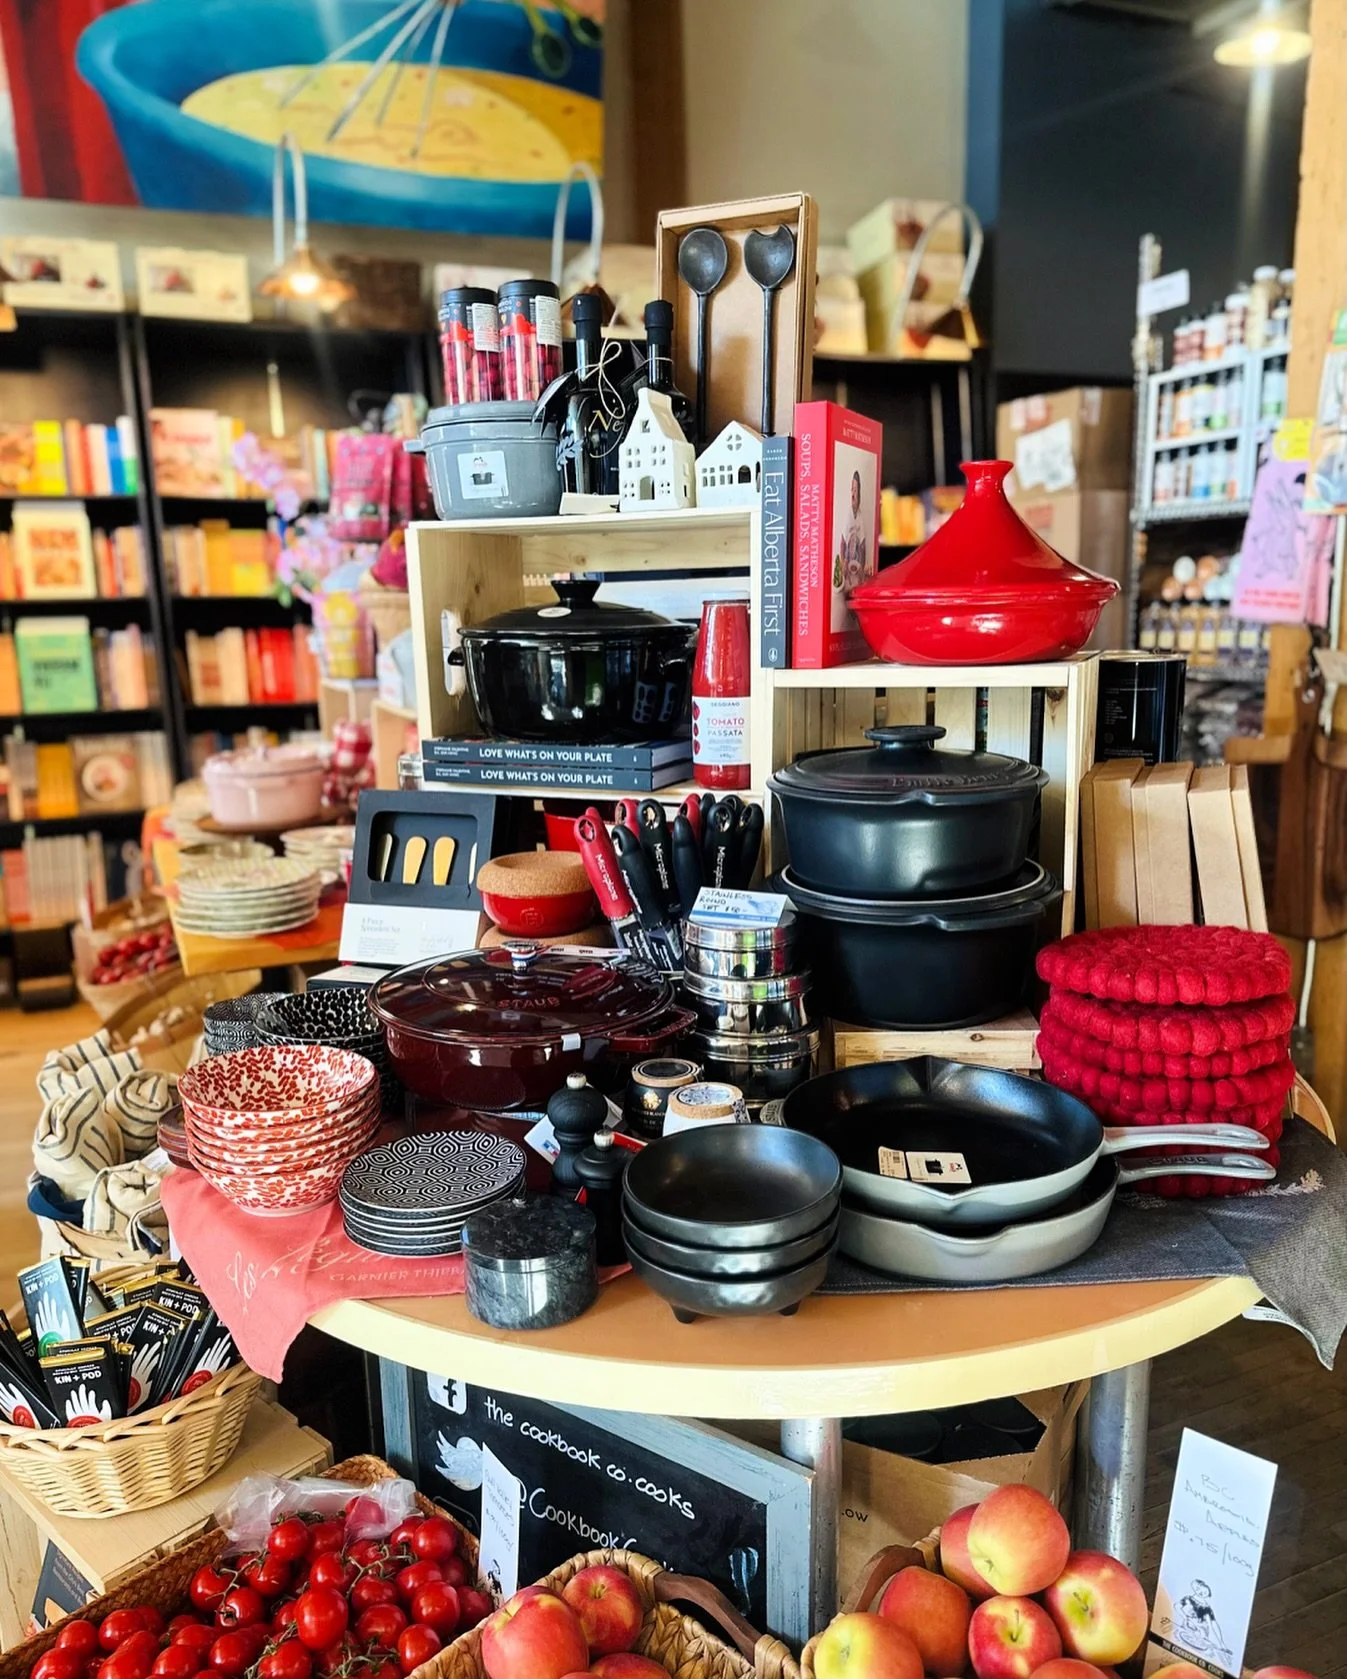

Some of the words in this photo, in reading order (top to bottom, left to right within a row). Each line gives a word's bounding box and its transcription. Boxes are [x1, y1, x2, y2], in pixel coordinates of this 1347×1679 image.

[800, 433, 811, 481] SOUPS,
[764, 472, 784, 507] Eat
[811, 484, 820, 523] MATTY
[799, 484, 810, 542] SALADS,
[764, 510, 785, 588] Alberta
[810, 525, 819, 588] MATHESON
[798, 546, 810, 636] SANDWICHES
[764, 593, 783, 637] First
[707, 717, 745, 726] TOMATO
[479, 747, 503, 758] LOVE
[505, 749, 537, 760] WHAT'S
[539, 750, 554, 761] ON
[556, 751, 583, 762] YOUR
[585, 752, 613, 763] PLATE
[480, 769, 505, 780] LOVE
[506, 771, 539, 782] WHAT'S
[540, 772, 555, 783] ON
[557, 773, 583, 784] YOUR
[585, 774, 613, 785] PLATE
[26, 1283, 39, 1295] KIN
[45, 1274, 59, 1289] POD
[329, 1270, 409, 1282] GARNIER
[158, 1296, 173, 1309] KIN
[180, 1302, 199, 1315] POD
[142, 1320, 158, 1334] KIN
[54, 1375, 72, 1385] KIN
[82, 1370, 102, 1381] POD
[484, 1396, 514, 1428] the
[519, 1421, 602, 1471] cookbook
[842, 1508, 869, 1522] OW
